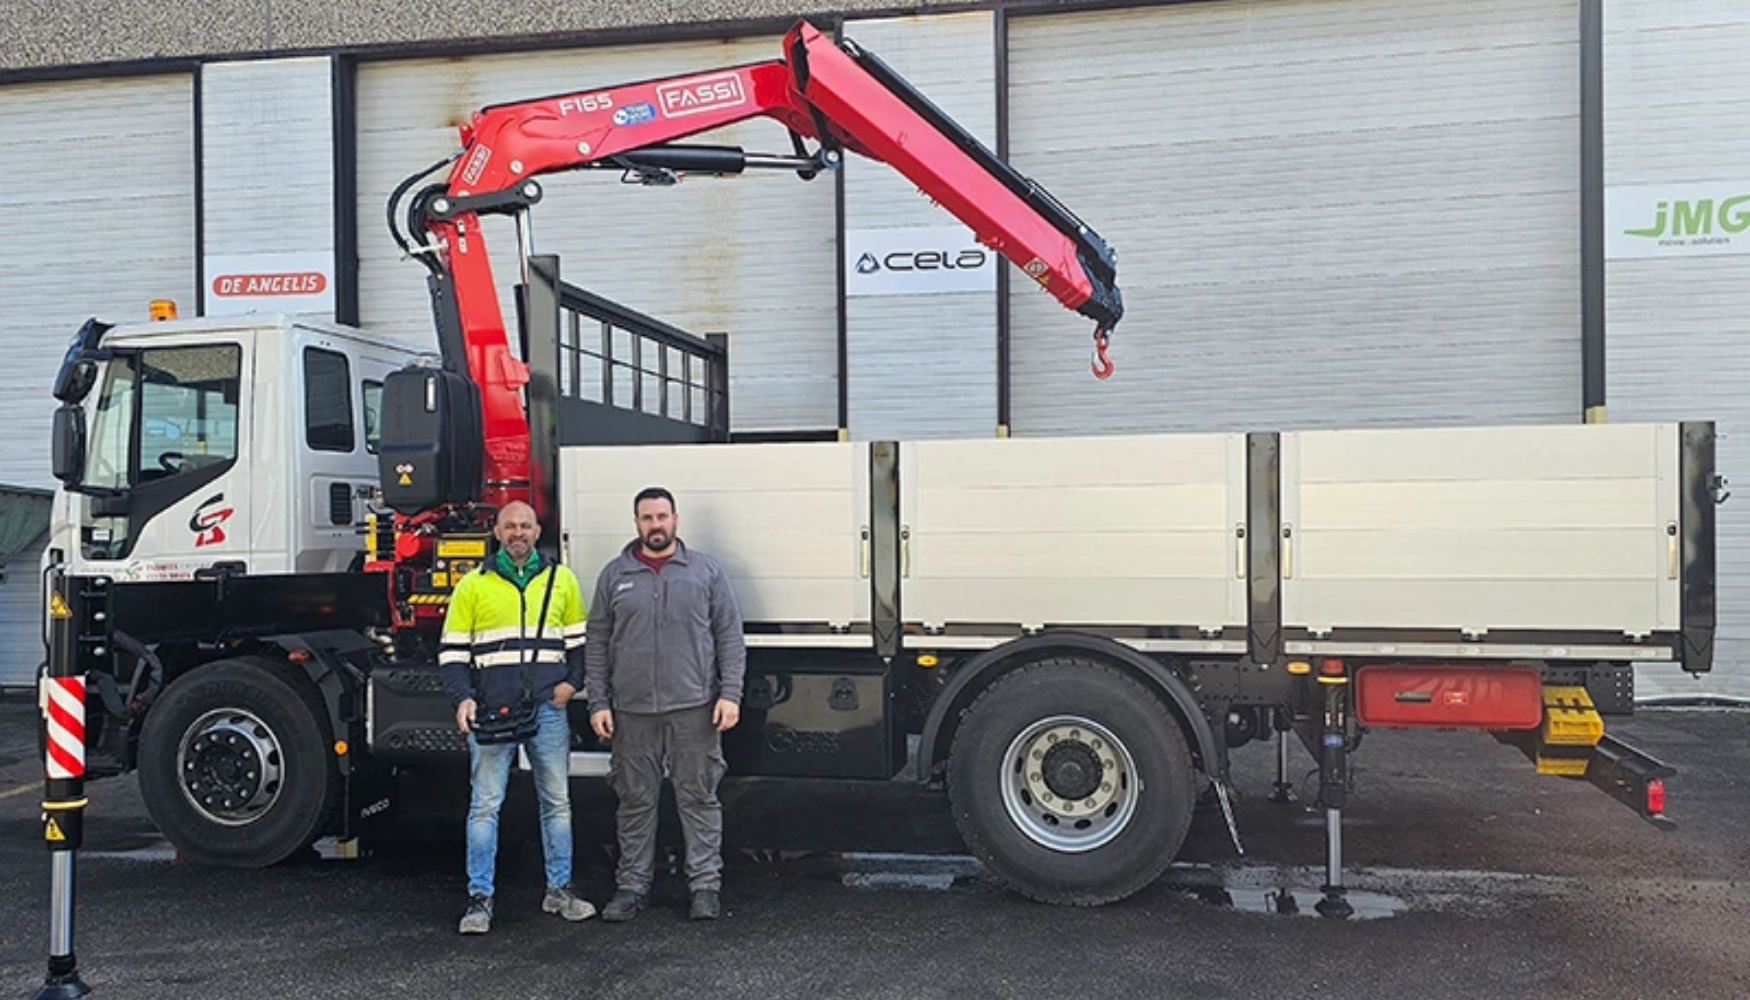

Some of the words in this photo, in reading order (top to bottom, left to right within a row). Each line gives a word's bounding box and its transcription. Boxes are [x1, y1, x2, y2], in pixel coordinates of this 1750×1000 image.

[558, 93, 613, 116] F165
[665, 82, 738, 109] FASSI
[465, 147, 487, 181] FASSI
[221, 278, 243, 294] DE
[246, 275, 318, 293] ANGELIS
